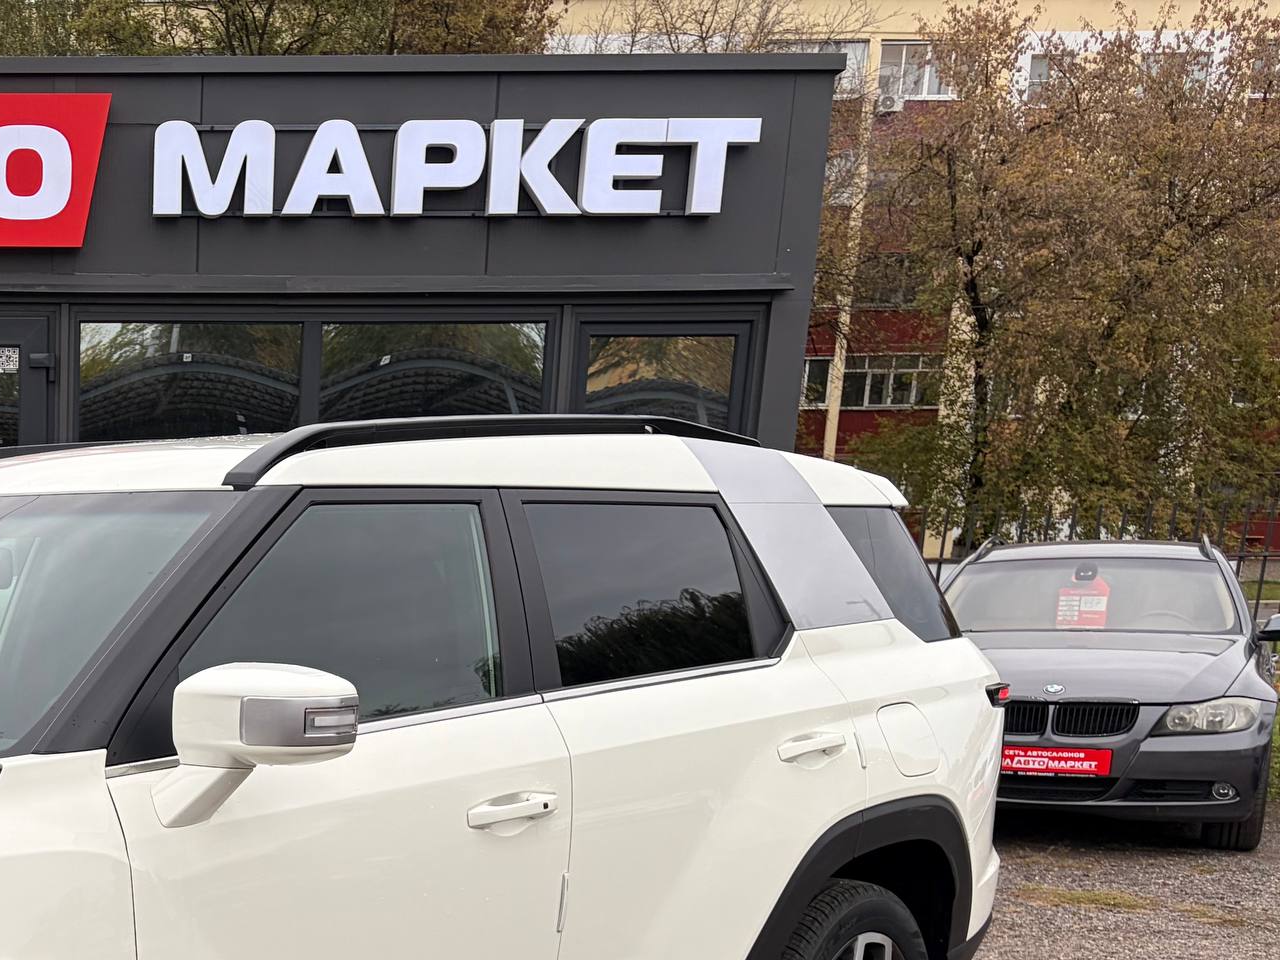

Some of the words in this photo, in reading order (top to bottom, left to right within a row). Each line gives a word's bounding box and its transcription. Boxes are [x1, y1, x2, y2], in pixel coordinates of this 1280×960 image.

[152, 117, 763, 217] МАРКЕТ
[1026, 750, 1085, 758] АВТОСАЛОНОВ
[1015, 758, 1047, 768] АВТО
[1048, 760, 1099, 769] МАРКЕТ
